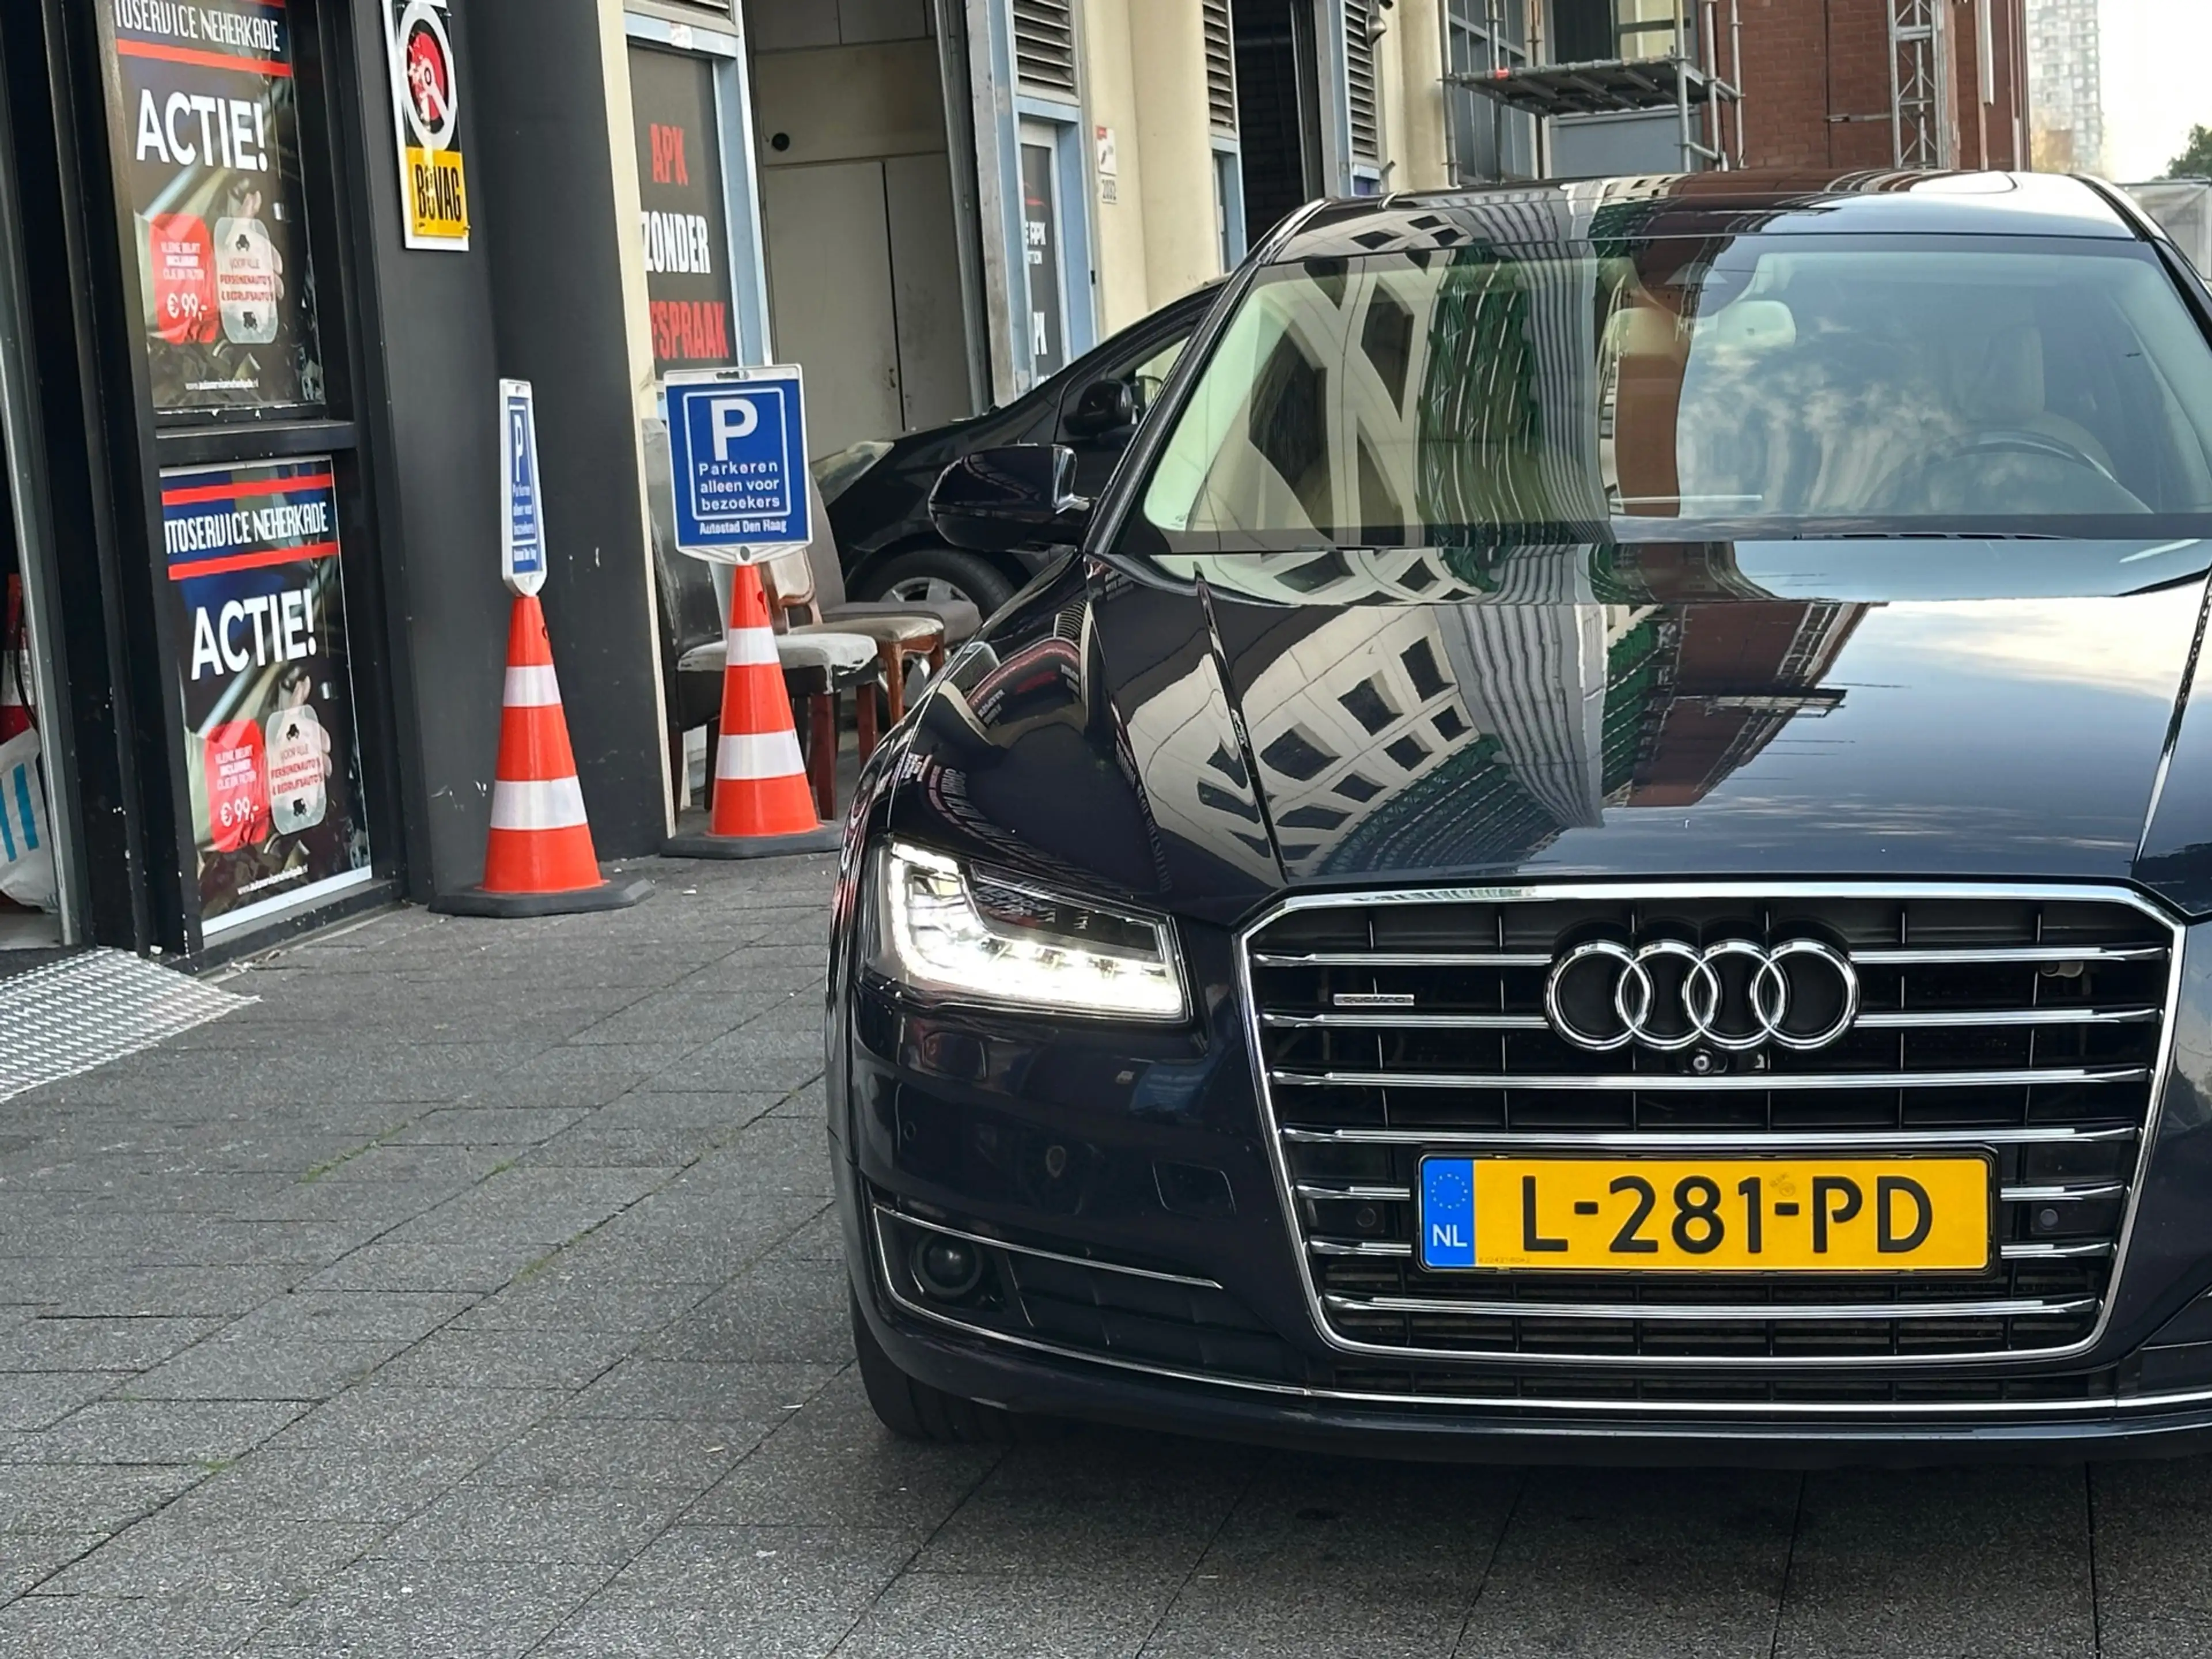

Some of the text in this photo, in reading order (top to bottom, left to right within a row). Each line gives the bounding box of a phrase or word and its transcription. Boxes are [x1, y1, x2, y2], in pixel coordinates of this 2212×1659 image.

[199, 8, 281, 52] NEHERKADE
[136, 88, 269, 172] ACTIE!
[650, 123, 689, 187] APK
[415, 164, 461, 222] BOVAG
[641, 211, 711, 274] ZONDER
[167, 293, 180, 319] €
[514, 414, 523, 482] P
[711, 399, 759, 462] P
[698, 461, 778, 476] Parkeren
[700, 479, 780, 494] alleen voor
[252, 501, 329, 543] NEHERKADE
[700, 495, 780, 512] bezoekers
[699, 518, 787, 535] Autostad Den Haag
[191, 588, 317, 681] ACTIE!
[220, 802, 233, 827] €
[1432, 1224, 1467, 1248] NL
[1522, 1175, 1934, 1255] L-281-PD
